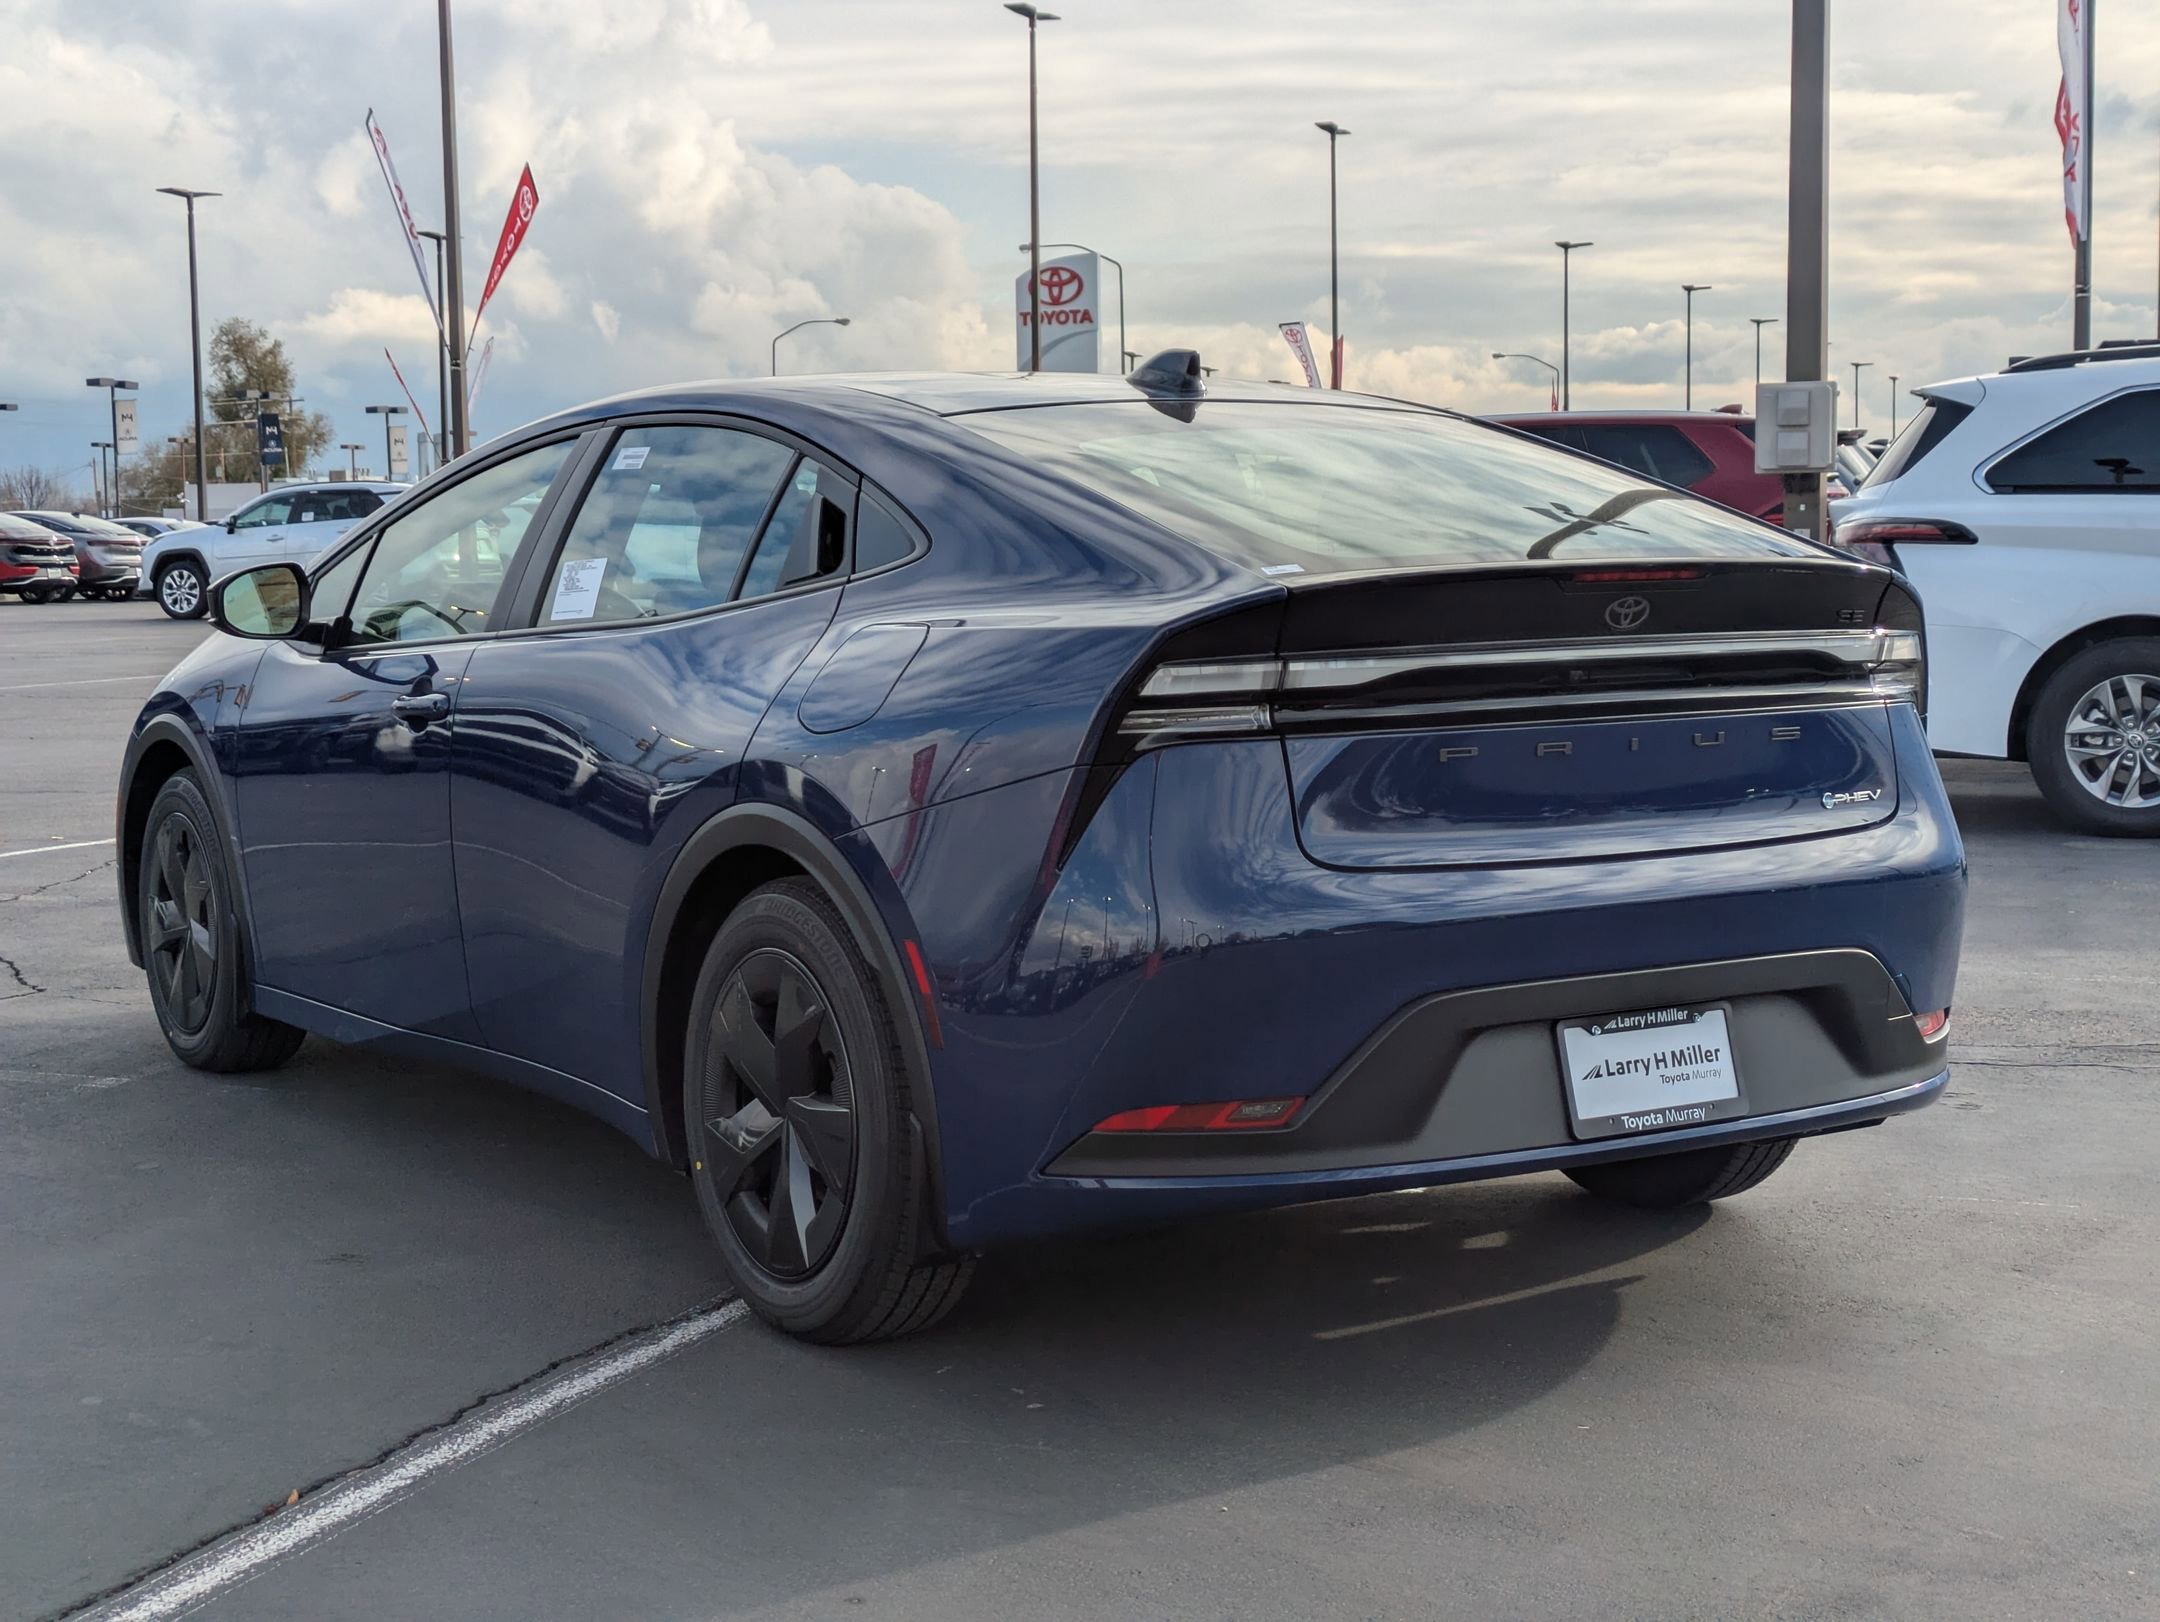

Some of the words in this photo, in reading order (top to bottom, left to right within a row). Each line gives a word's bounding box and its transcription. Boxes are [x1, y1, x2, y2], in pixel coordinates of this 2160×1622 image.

[1837, 609, 1865, 623] SE
[1439, 726, 1801, 763] PRIUS
[764, 897, 848, 978] BRIDGESTONE
[1617, 1015, 1646, 1029] Larry
[1647, 1013, 1656, 1024] H
[1657, 1008, 1688, 1023] Miller
[1605, 1057, 1651, 1077] Larry
[1654, 1051, 1668, 1070] H
[1671, 1044, 1721, 1068] Miller
[1660, 1069, 1691, 1085] Toyota
[1692, 1067, 1722, 1081] Murray
[1621, 1112, 1664, 1130] Toyota
[1665, 1105, 1706, 1123] Murray
